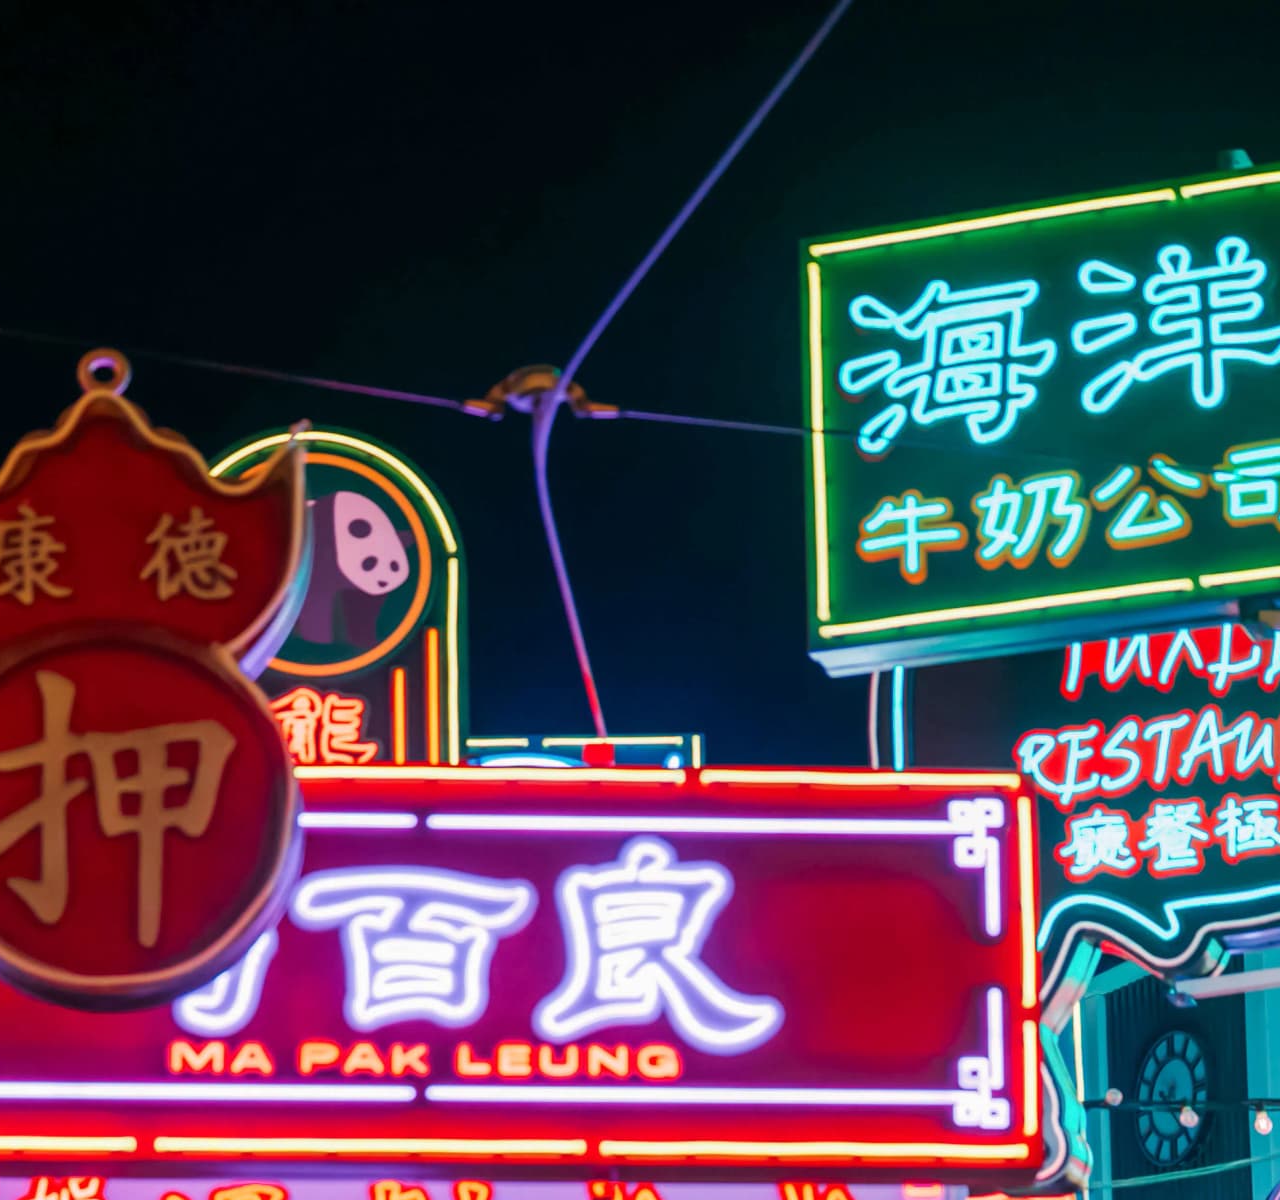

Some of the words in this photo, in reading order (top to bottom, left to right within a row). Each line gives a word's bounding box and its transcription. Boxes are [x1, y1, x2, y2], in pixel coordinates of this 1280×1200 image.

[175, 838, 784, 1054] 百良
[169, 1042, 276, 1076] MA
[299, 1043, 431, 1077] PAK
[456, 1043, 682, 1078] LEUNG
